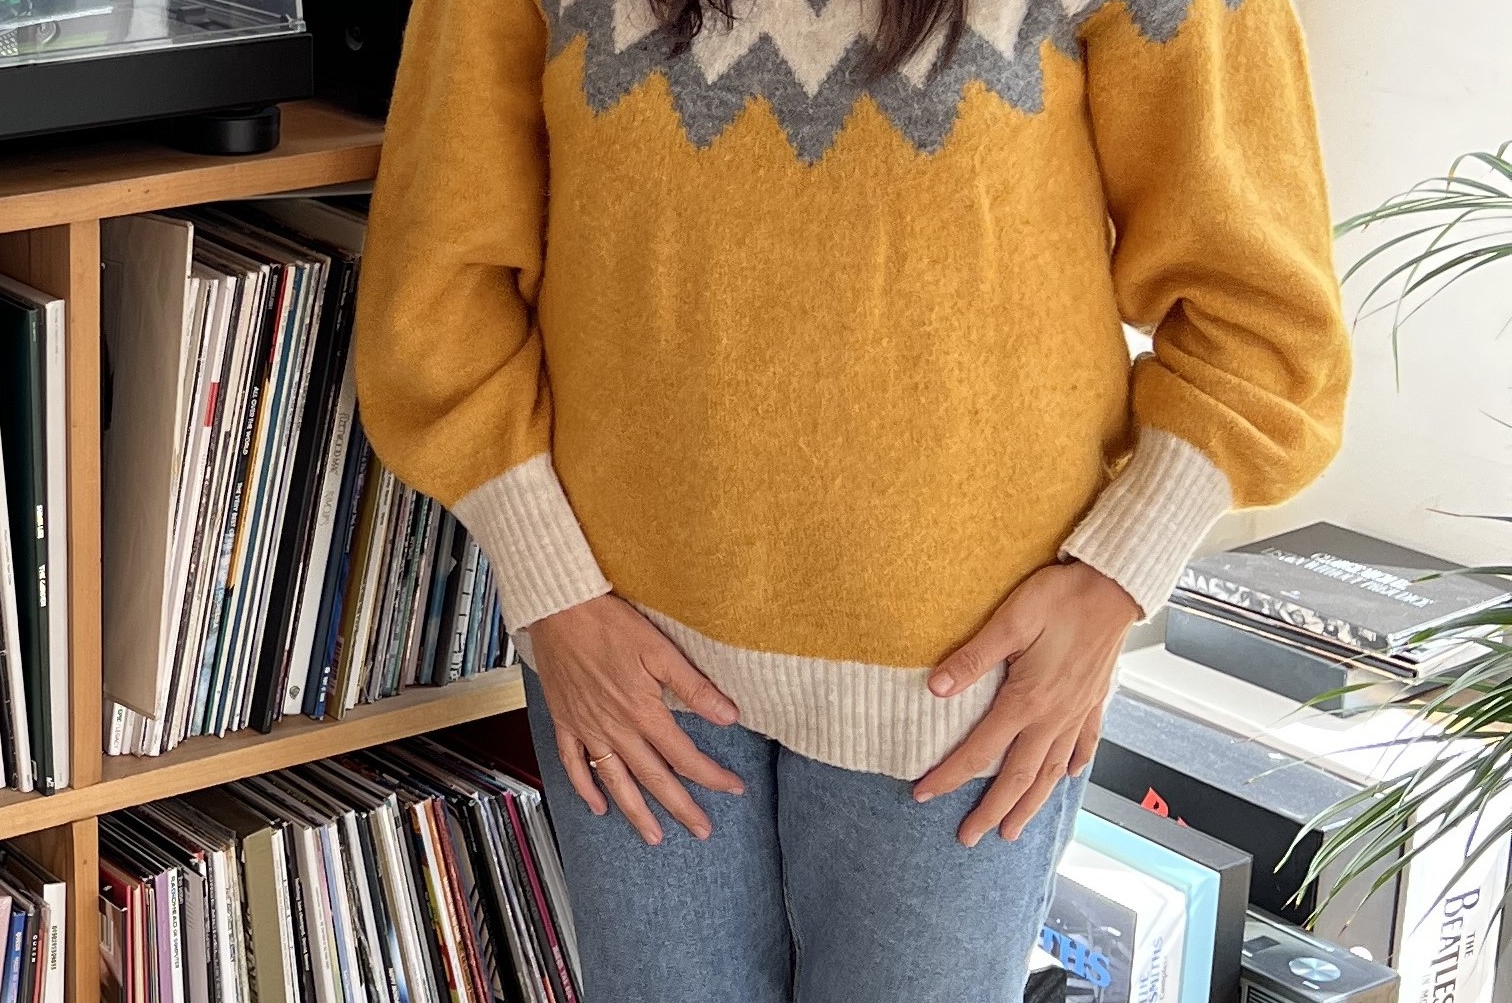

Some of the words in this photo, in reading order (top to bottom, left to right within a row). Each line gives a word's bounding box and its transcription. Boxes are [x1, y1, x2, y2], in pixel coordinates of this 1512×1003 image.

[251, 386, 260, 398] ALL
[248, 399, 258, 417] OVER
[242, 430, 253, 455] WORLD
[1430, 887, 1481, 1003] BEATLES
[1464, 931, 1476, 959] THE
